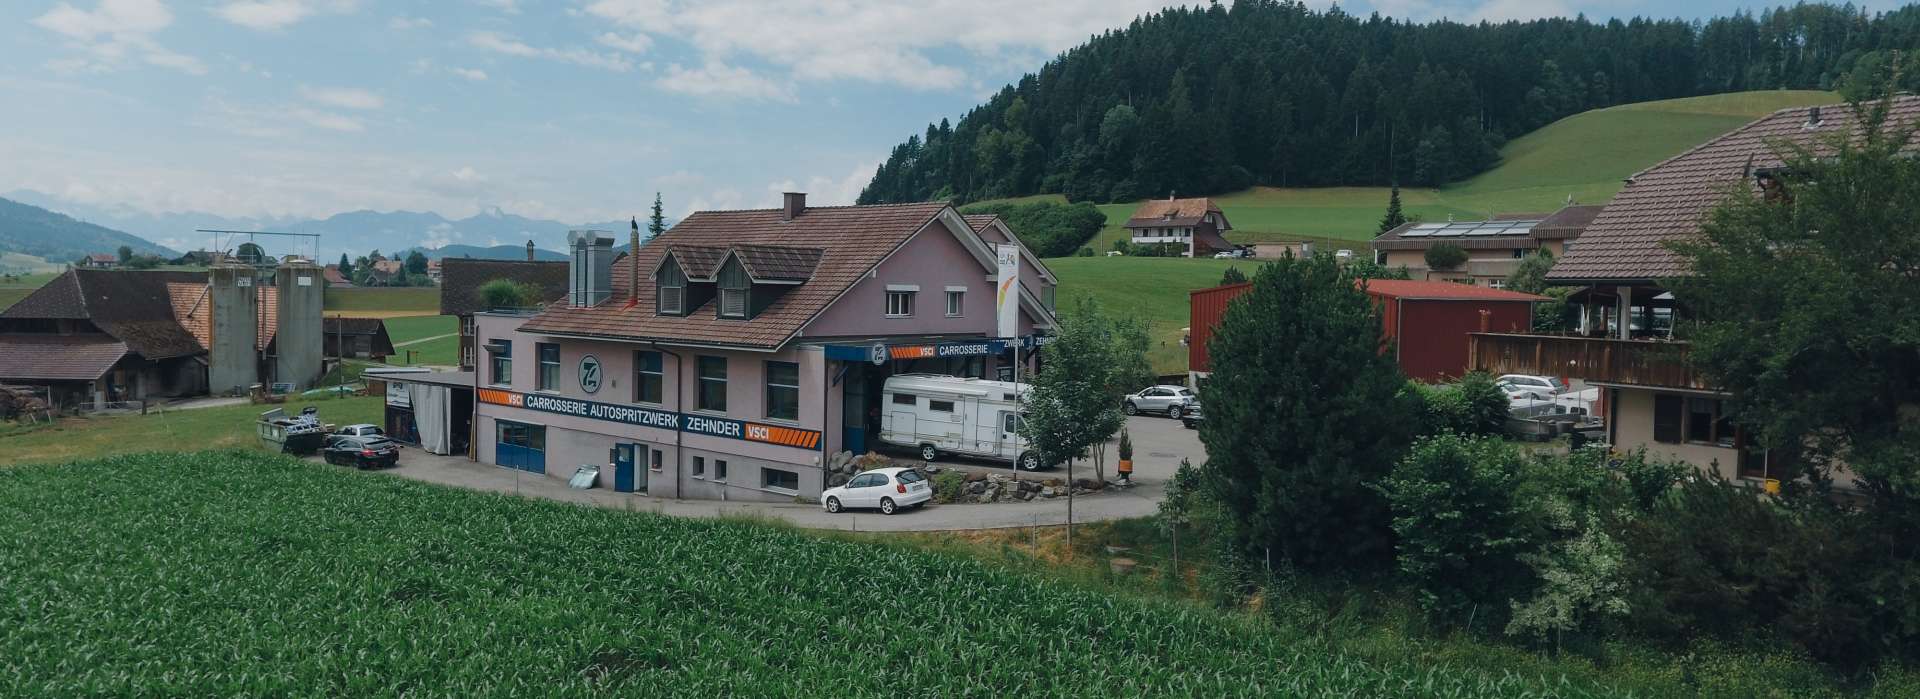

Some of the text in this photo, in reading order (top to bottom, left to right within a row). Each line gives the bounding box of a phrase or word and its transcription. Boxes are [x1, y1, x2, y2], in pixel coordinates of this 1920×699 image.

[920, 344, 988, 357] VSCI CARROSSERIE
[508, 393, 769, 440] VSCI CARROSSERIE AUTOSPRITZWERK ZEHNDER VSCI
